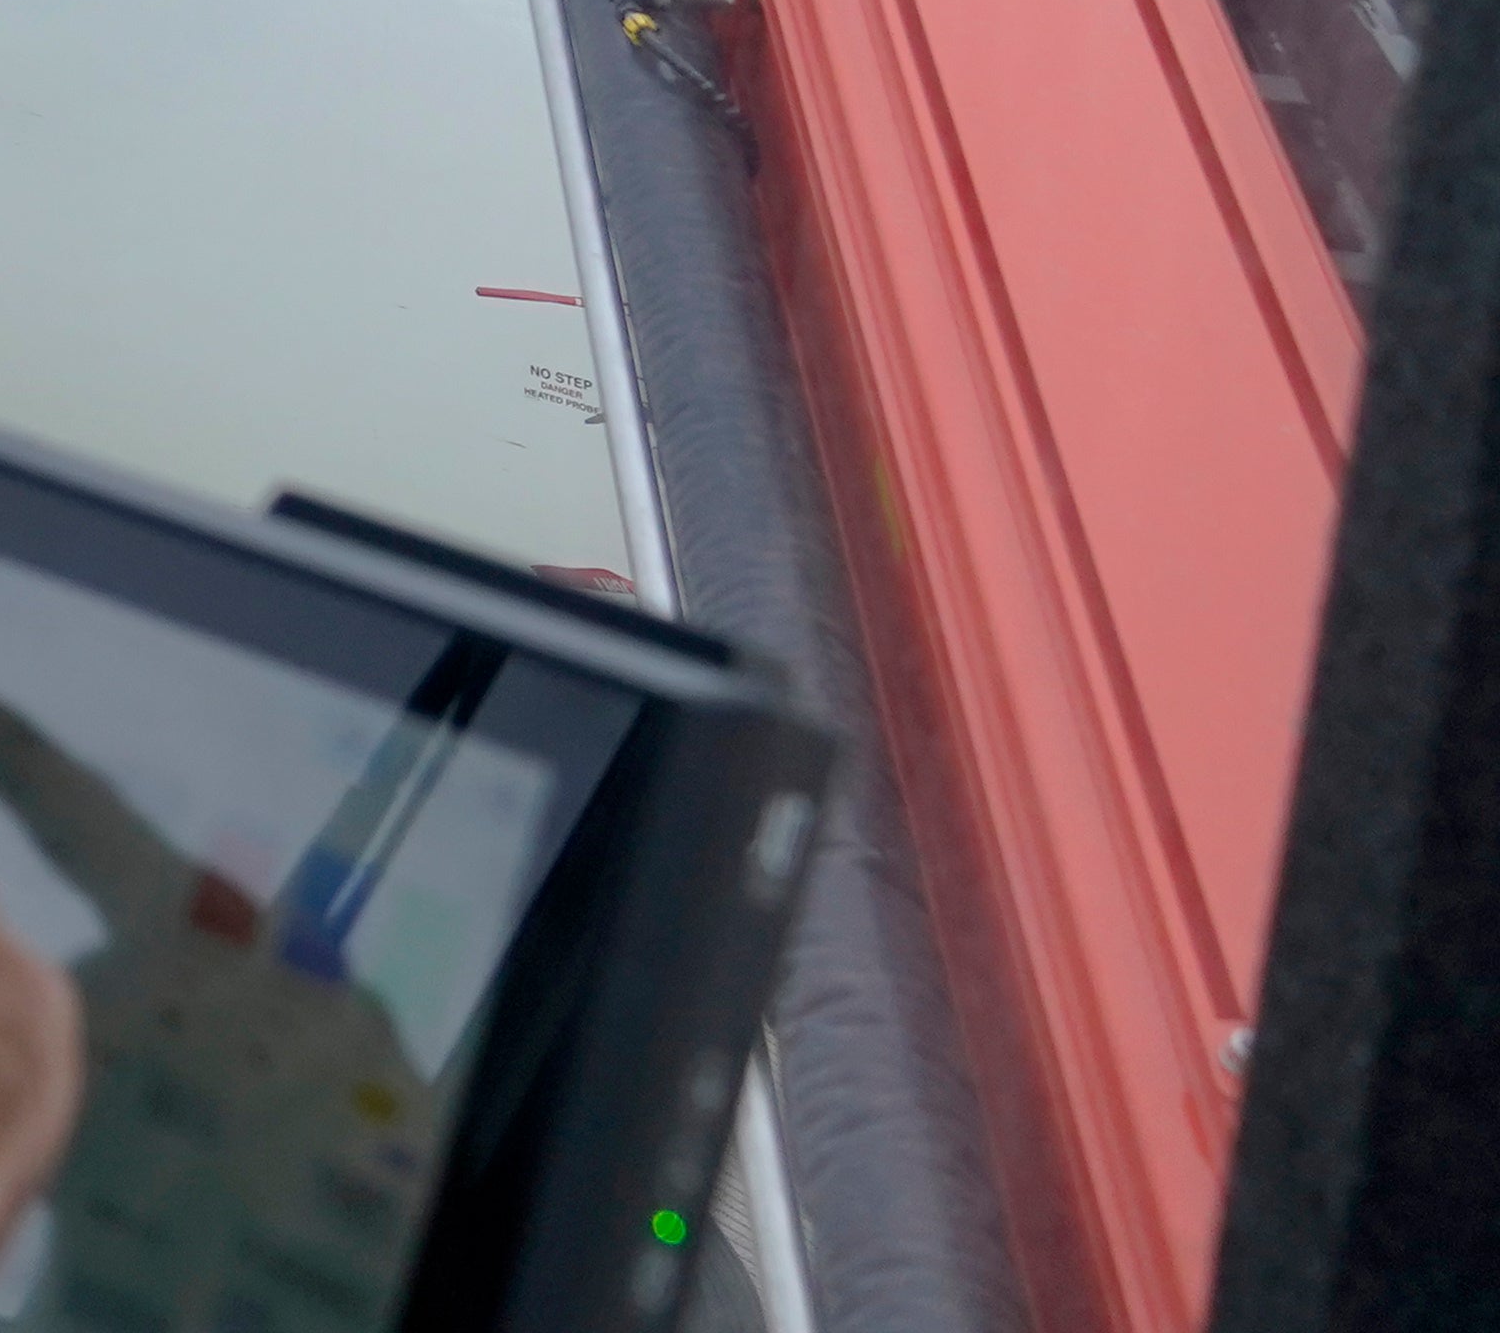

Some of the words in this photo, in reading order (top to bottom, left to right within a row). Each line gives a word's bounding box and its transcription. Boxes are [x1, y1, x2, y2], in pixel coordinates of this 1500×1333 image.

[530, 365, 551, 380] NO
[555, 372, 592, 390] STEP
[524, 388, 563, 404] HEATED
[541, 381, 583, 399] DANGER
